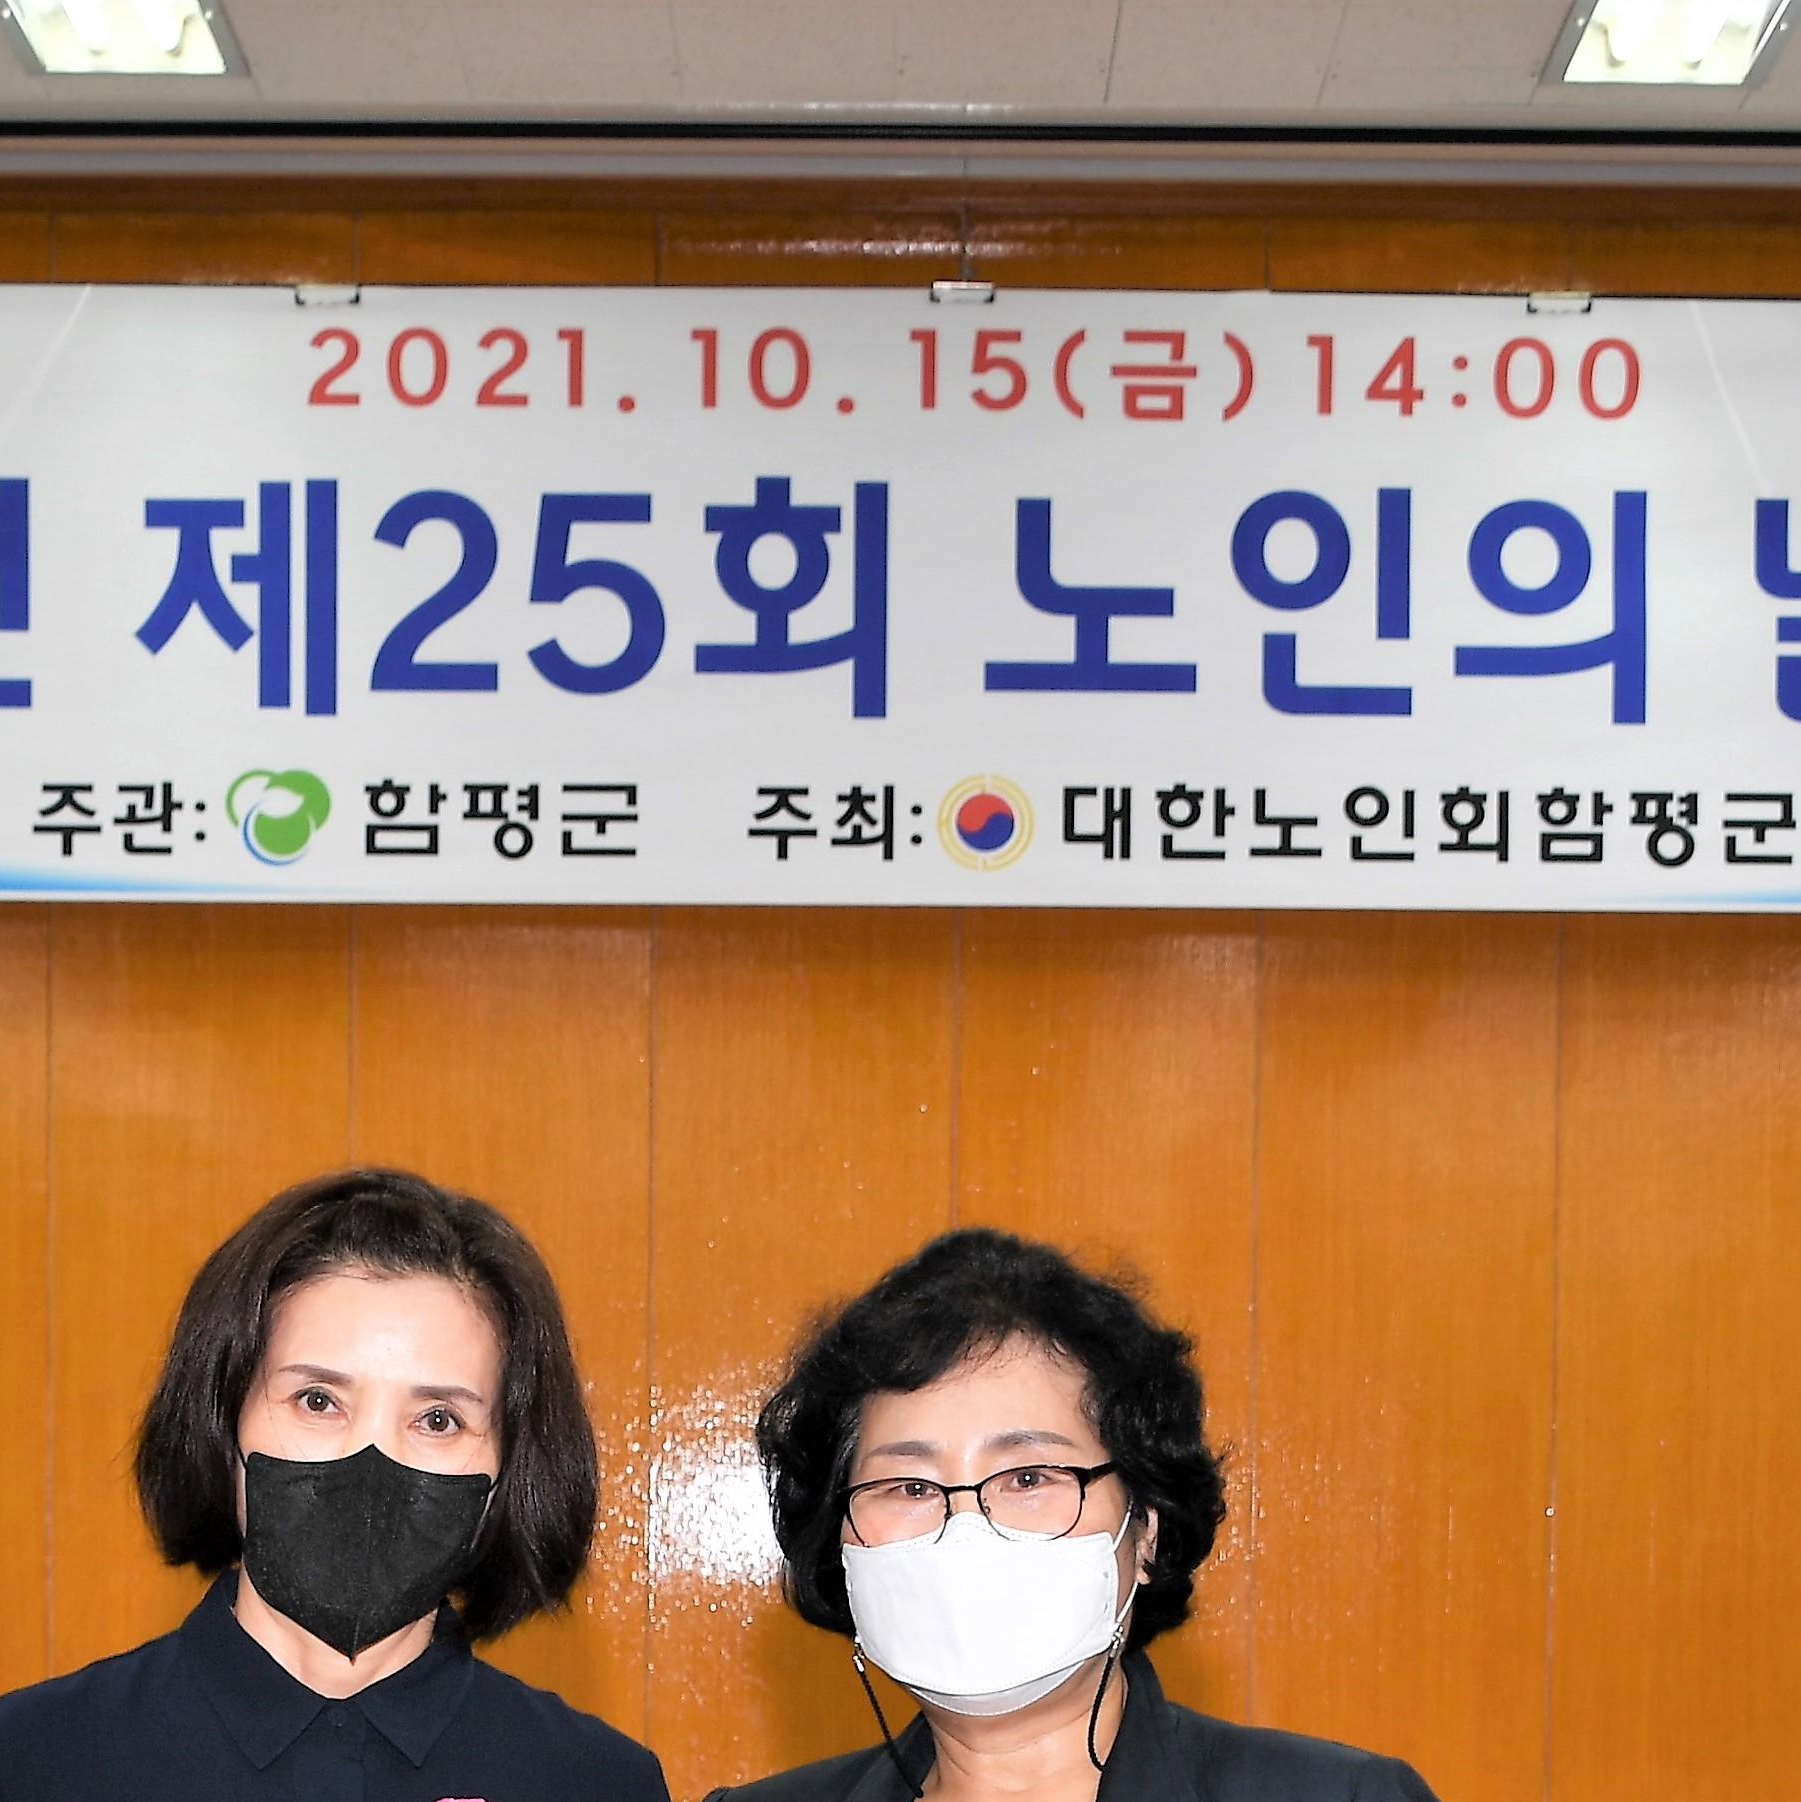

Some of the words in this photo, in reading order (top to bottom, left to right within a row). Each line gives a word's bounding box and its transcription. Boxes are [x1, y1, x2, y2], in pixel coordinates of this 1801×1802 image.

[310, 328, 634, 412] 2021.
[693, 329, 853, 413] 10.
[912, 330, 1254, 420] 15(금)
[1310, 336, 1640, 419] 14:00
[136, 477, 888, 718] 제25회
[985, 488, 1647, 724] 노인의
[34, 783, 205, 856] 주관:
[365, 780, 638, 859] 함평군
[749, 786, 922, 860] 주최:
